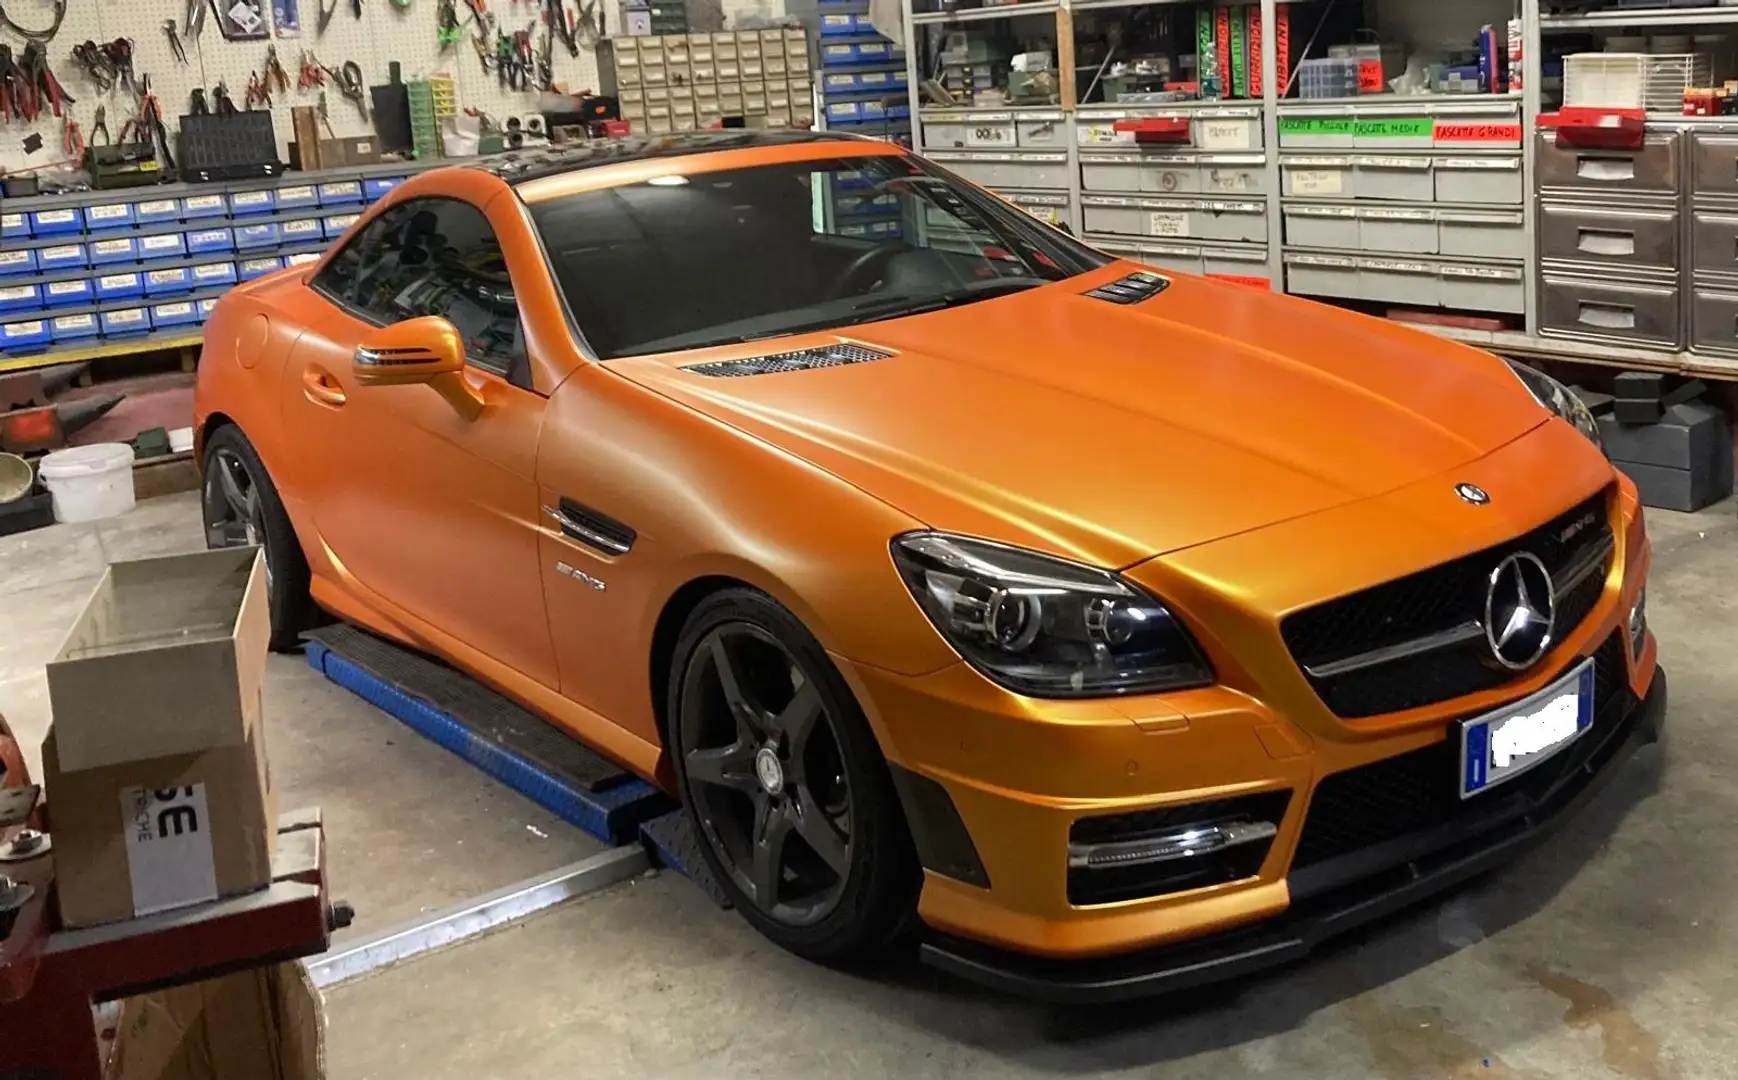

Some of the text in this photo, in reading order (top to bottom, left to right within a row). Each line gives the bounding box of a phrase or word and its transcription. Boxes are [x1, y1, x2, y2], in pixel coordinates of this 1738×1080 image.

[1354, 122, 1387, 134] FASCETTE
[1435, 126, 1515, 138] FASCETTE GRANDI
